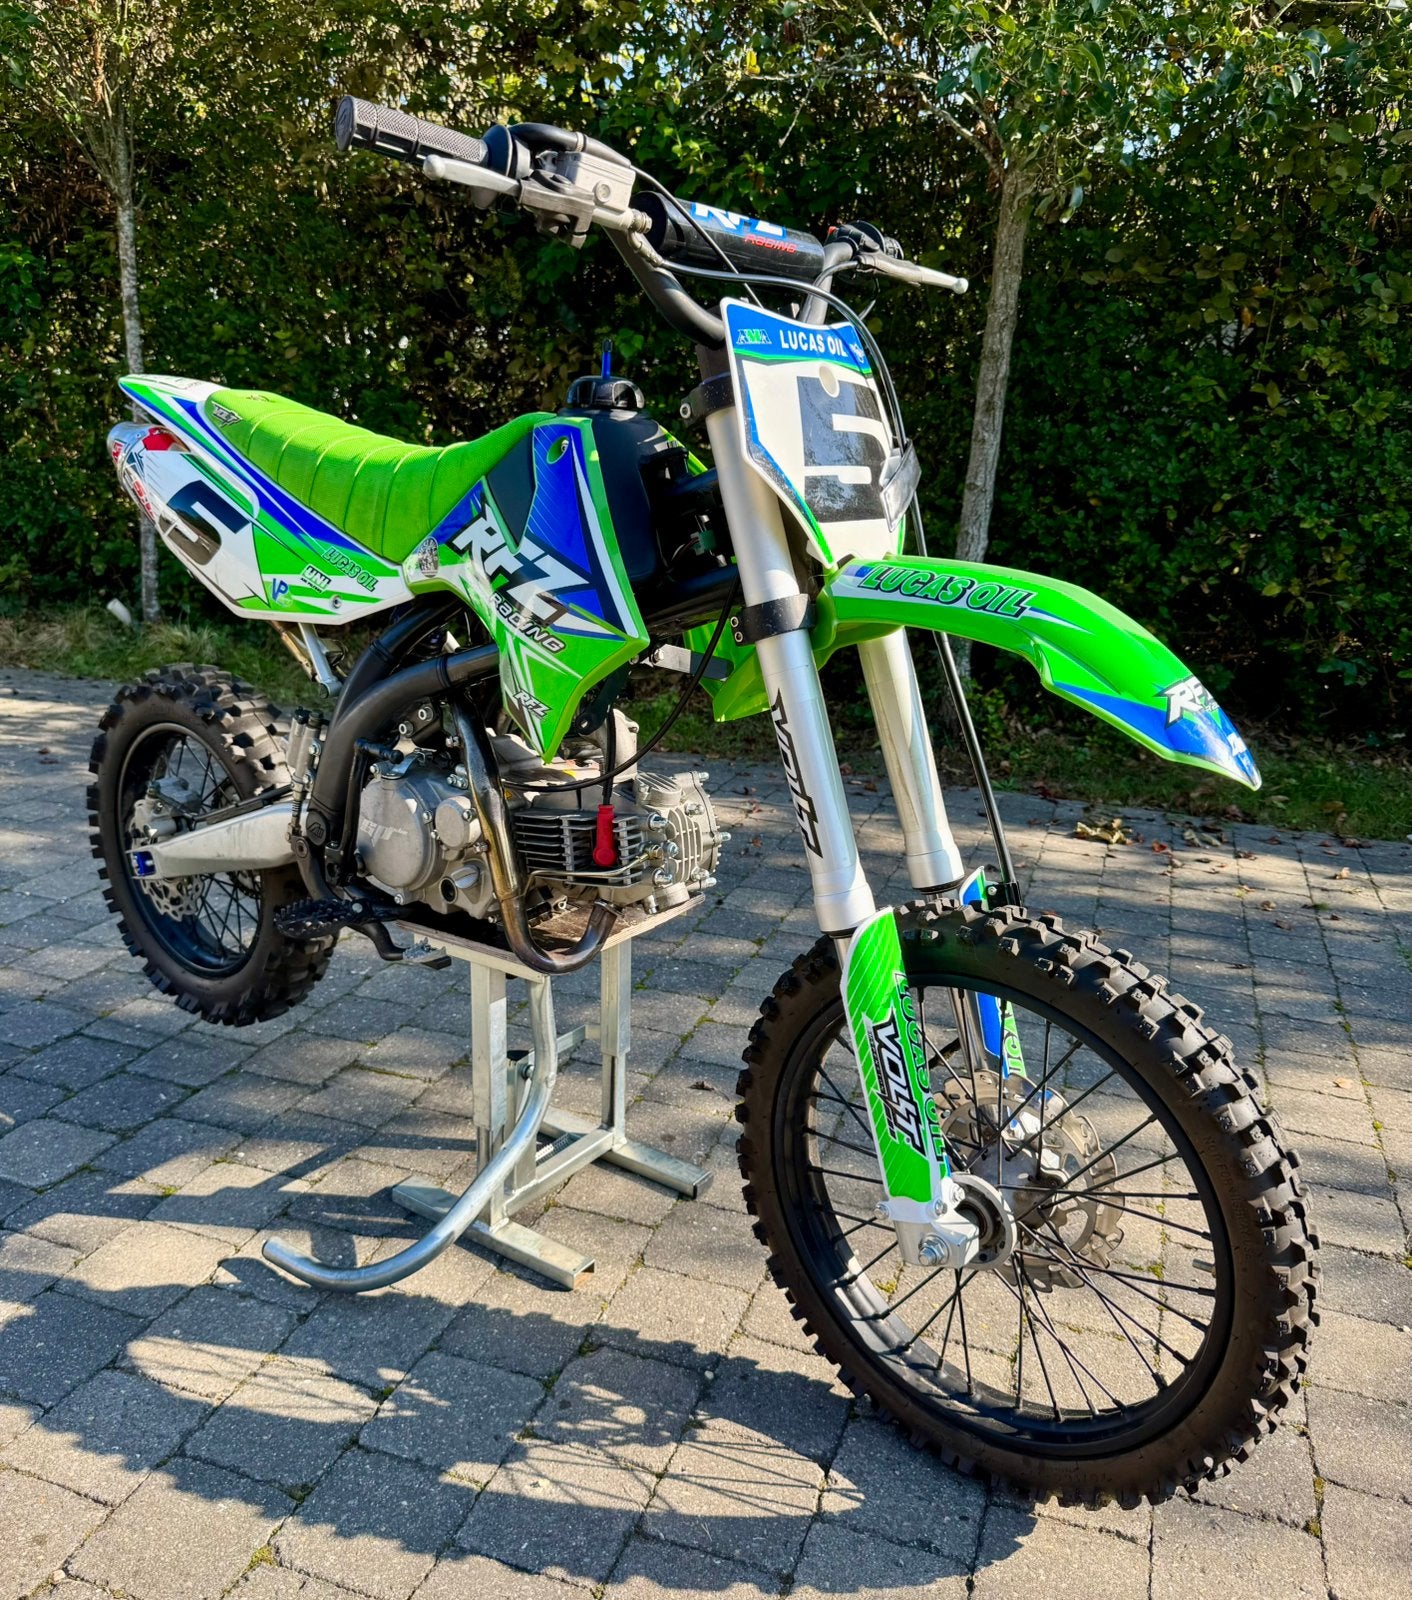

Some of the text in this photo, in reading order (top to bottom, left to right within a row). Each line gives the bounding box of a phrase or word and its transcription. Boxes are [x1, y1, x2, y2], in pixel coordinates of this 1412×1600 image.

[780, 329, 825, 353] LUCAS
[827, 335, 848, 357] OIL
[302, 565, 331, 590] UNI
[321, 547, 379, 592] LUCAS OIL
[452, 503, 590, 622] RFZ
[272, 578, 289, 601] VP
[858, 565, 1036, 618] LUCAS OIL
[513, 689, 552, 718] RFZ
[872, 1010, 927, 1156] VOLT
